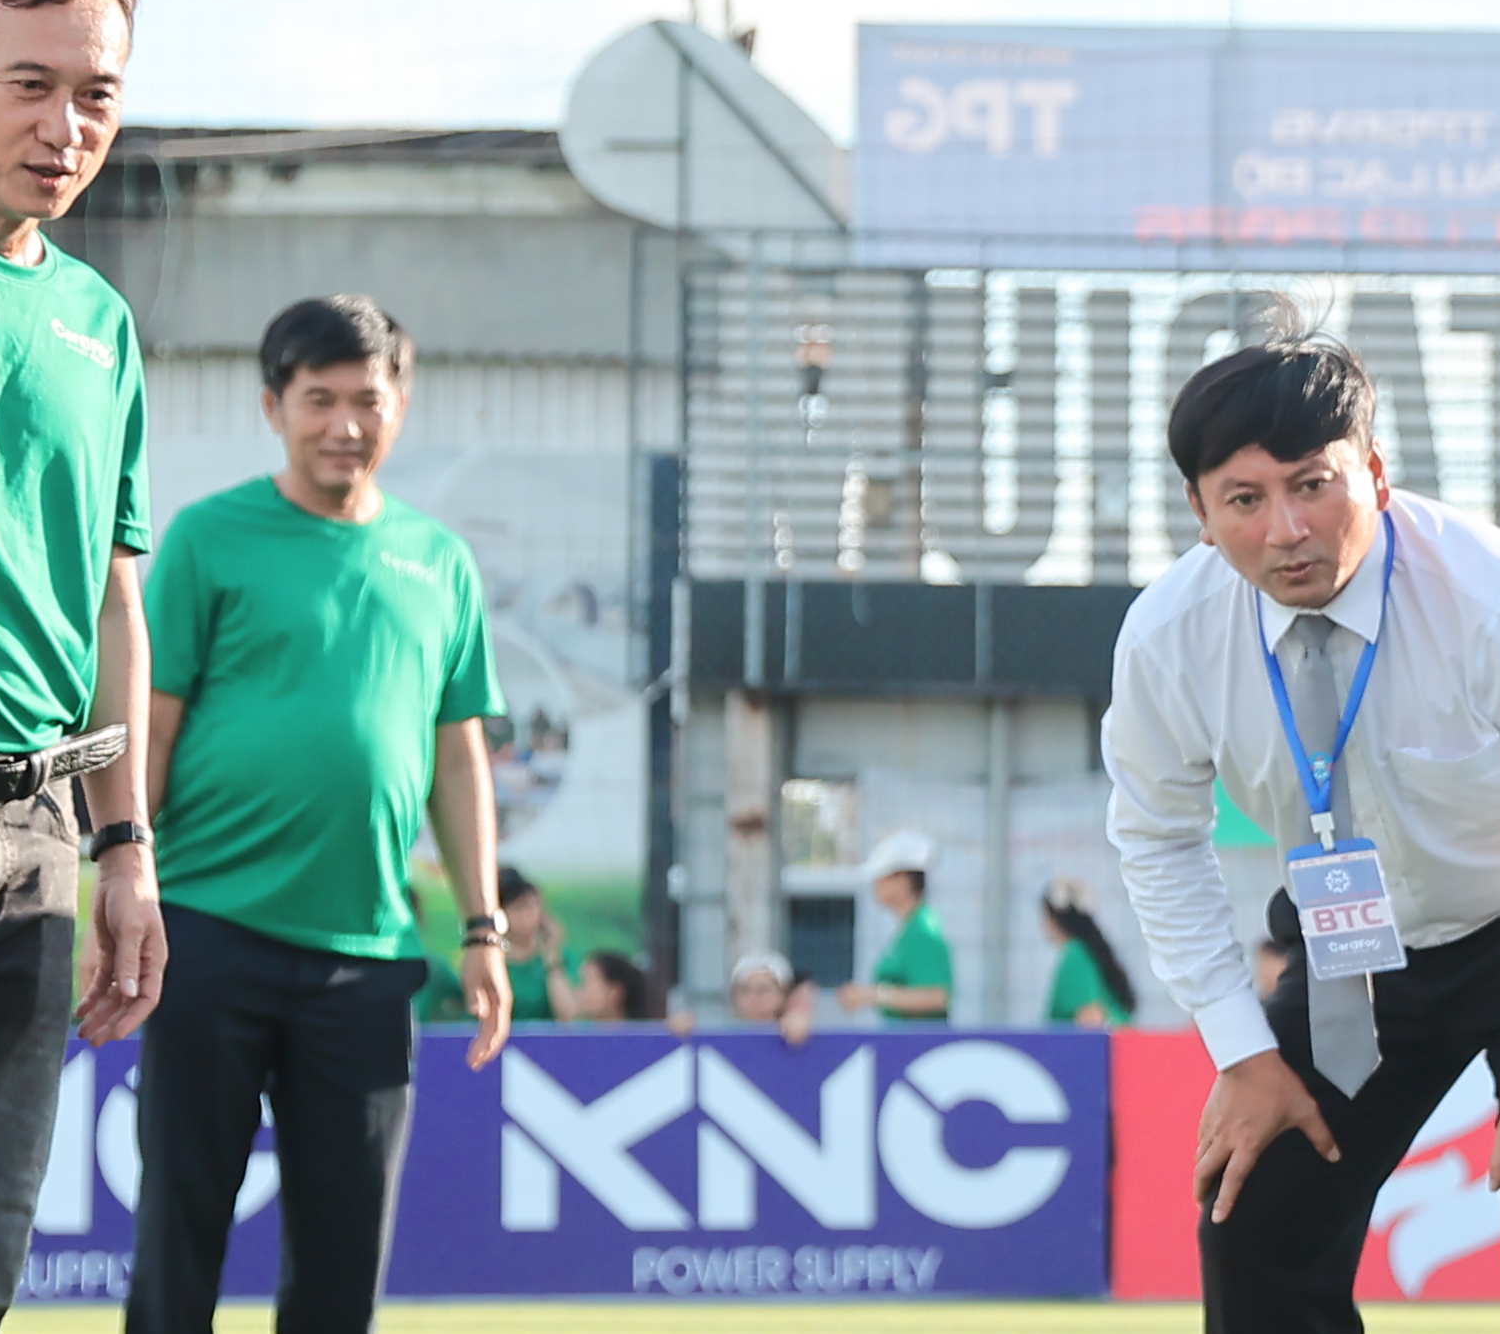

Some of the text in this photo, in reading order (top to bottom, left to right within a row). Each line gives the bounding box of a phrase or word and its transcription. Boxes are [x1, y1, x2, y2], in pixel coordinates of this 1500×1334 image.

[1312, 901, 1384, 934] BTC
[501, 1039, 1071, 1231] KNC
[17, 1250, 132, 1299] UPPL
[632, 1246, 943, 1294] POWER SUPPLY
